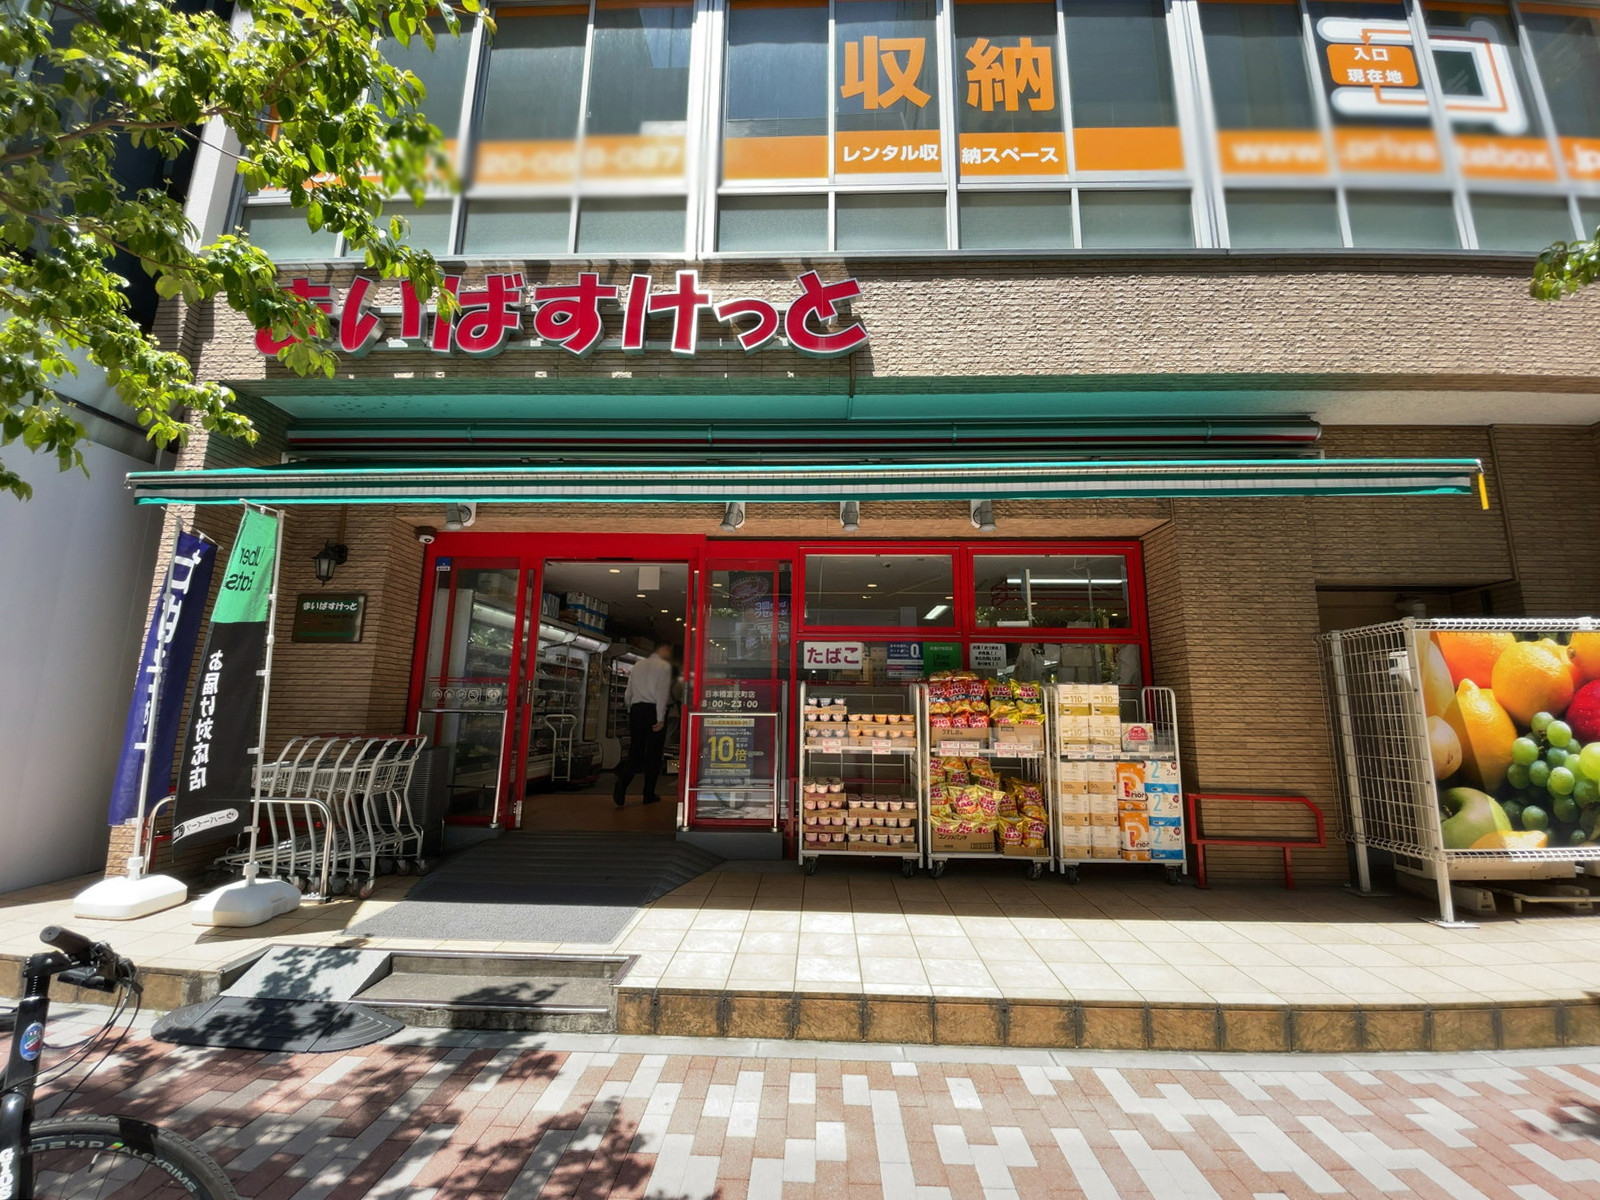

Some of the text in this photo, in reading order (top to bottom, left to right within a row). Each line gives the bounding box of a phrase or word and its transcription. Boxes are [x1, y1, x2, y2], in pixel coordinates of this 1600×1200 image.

[1353, 47, 1389, 61] 入口
[1347, 69, 1404, 84] 現在地
[302, 601, 358, 611] まいばすけっと
[807, 647, 860, 664] たばこ
[979, 797, 996, 805] BIG
[938, 833, 968, 841] コンソメパンチ
[121, 1145, 197, 1193] ALEXRIMS
